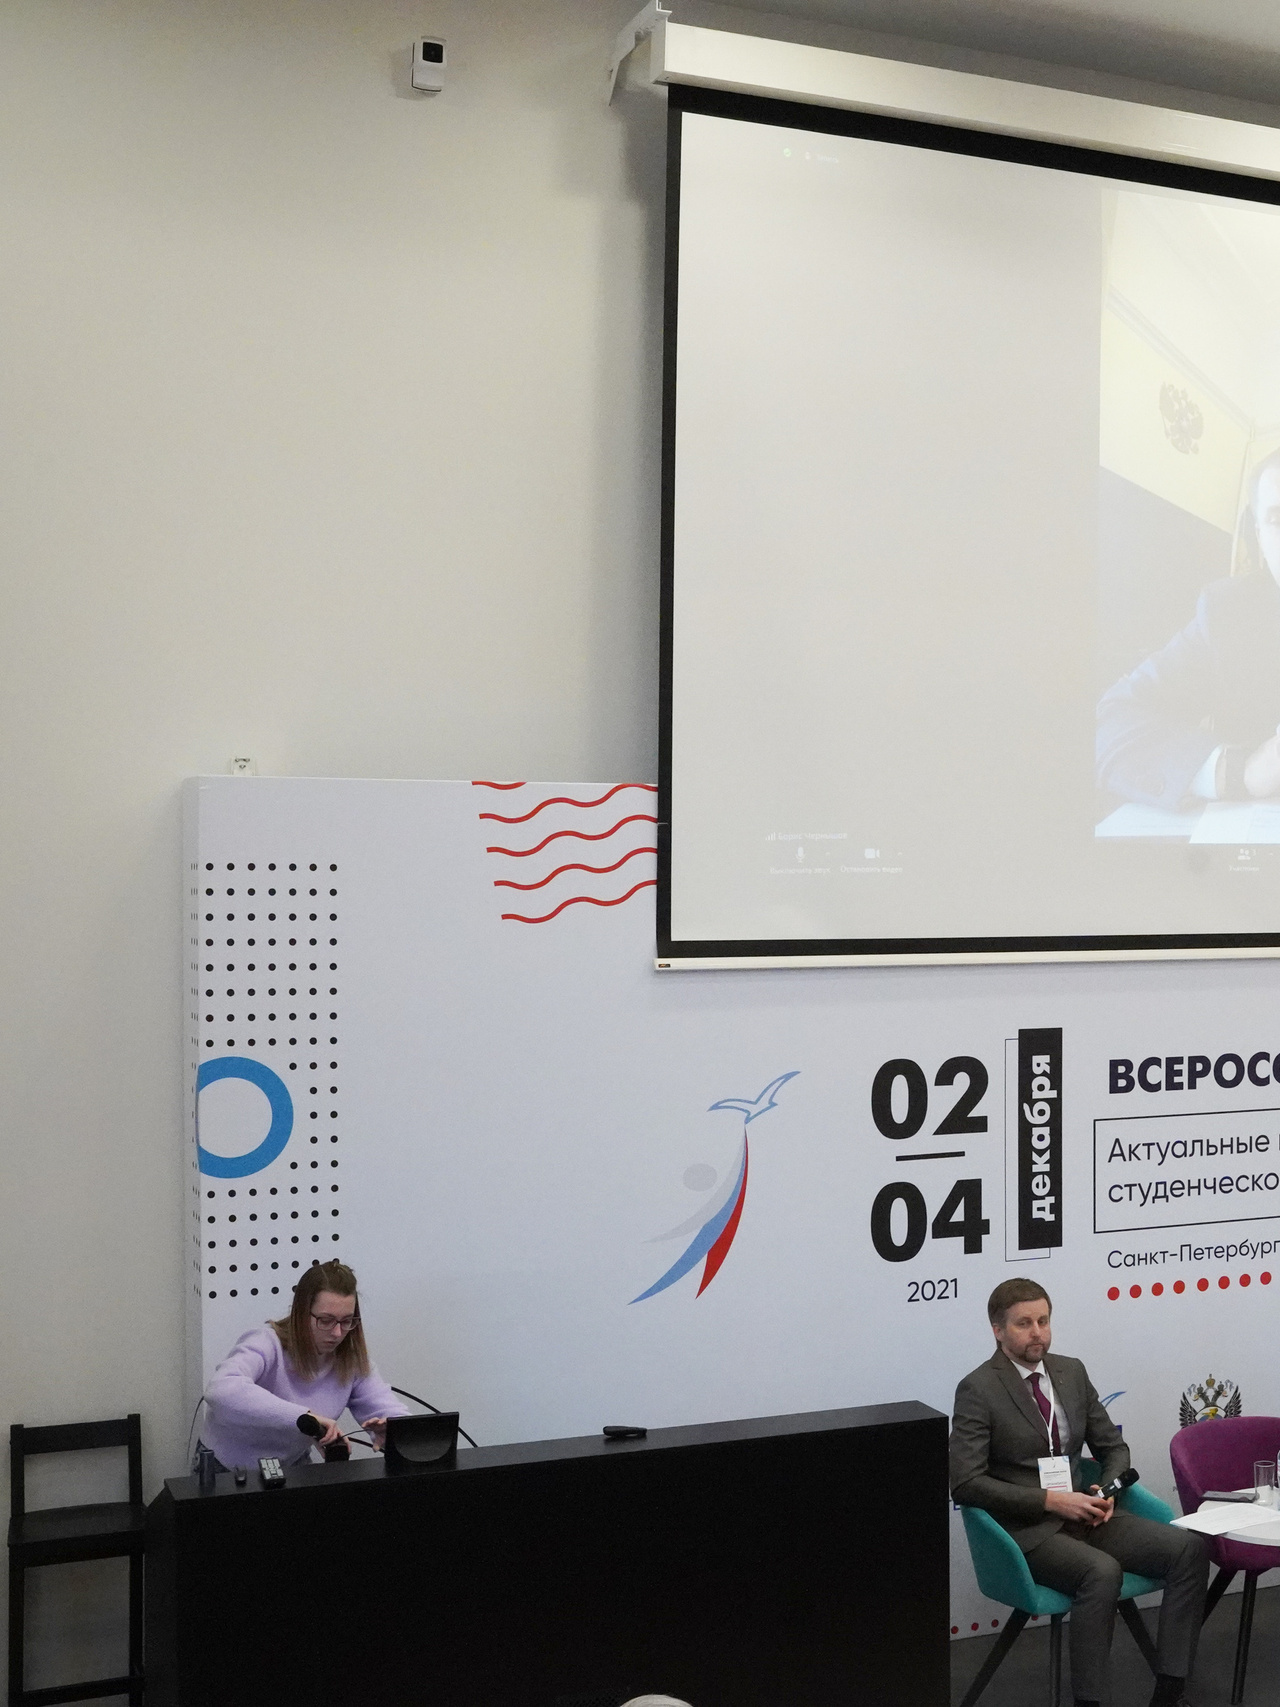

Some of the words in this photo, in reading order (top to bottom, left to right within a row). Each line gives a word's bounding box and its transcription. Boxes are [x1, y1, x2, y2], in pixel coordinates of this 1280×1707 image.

[870, 1055, 989, 1141] 02
[1030, 1053, 1062, 1223] декабря
[1107, 1133, 1271, 1164] Актуальные
[870, 1178, 990, 1263] 04
[907, 1278, 959, 1303] 2021
